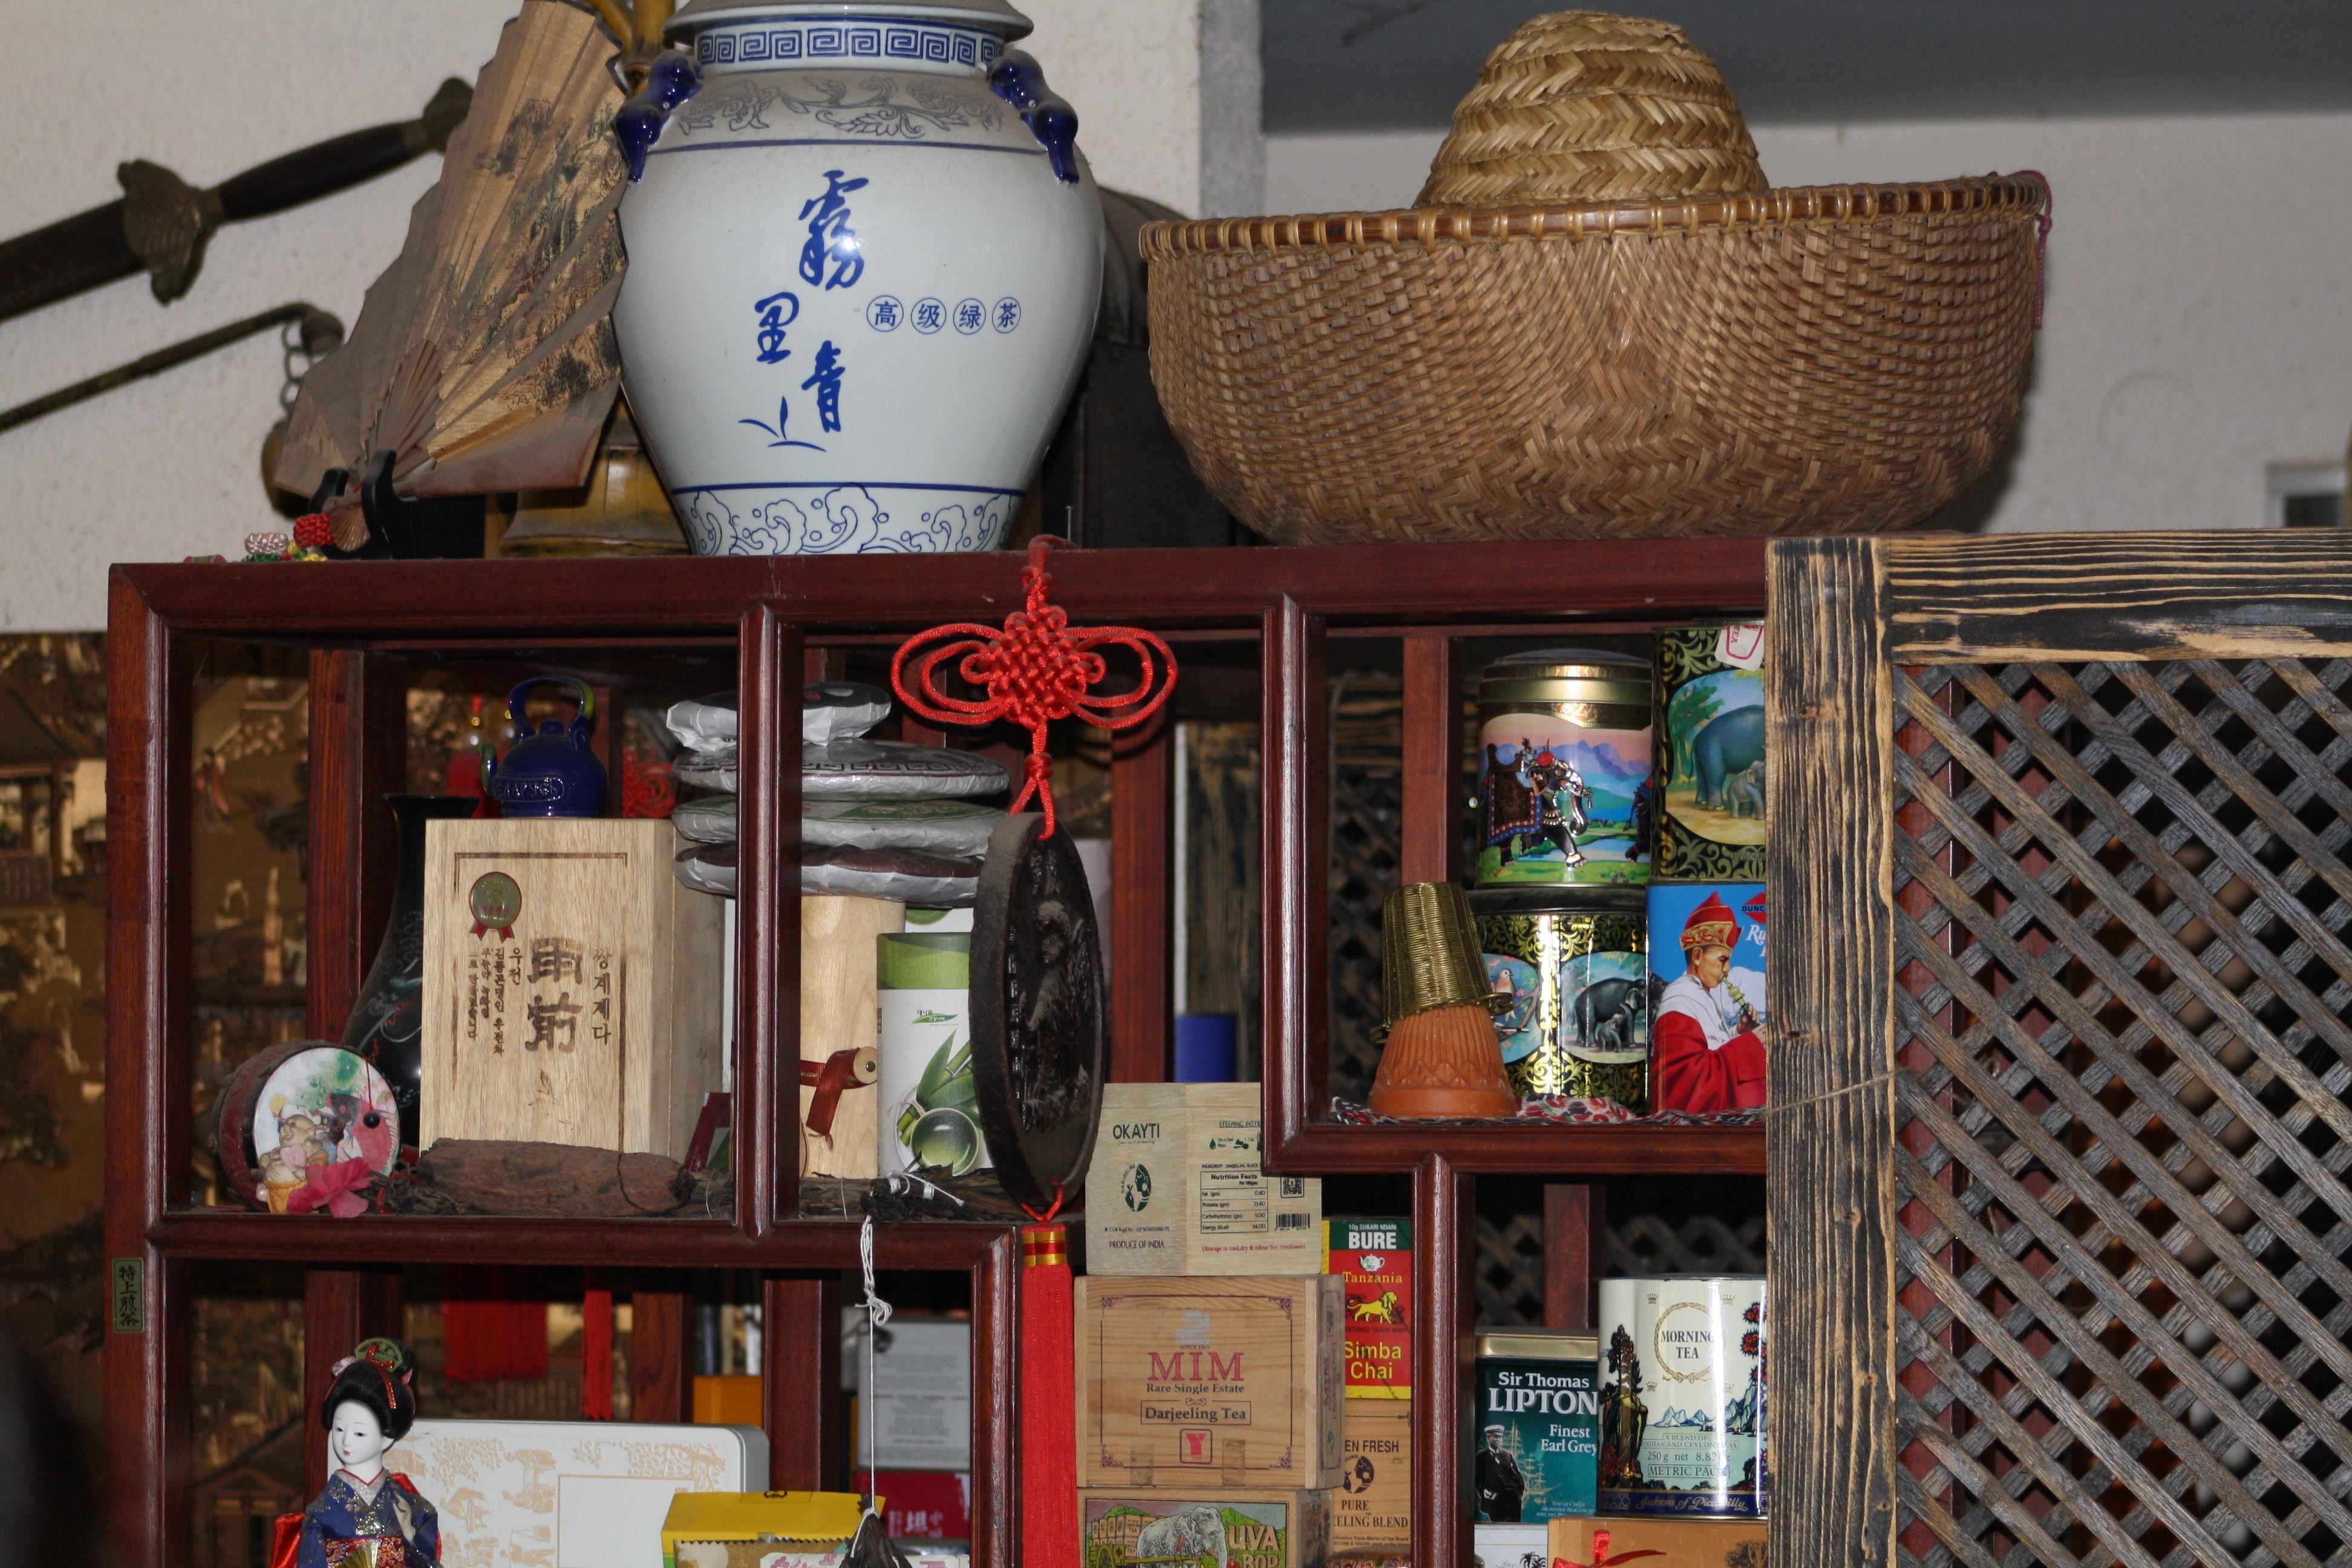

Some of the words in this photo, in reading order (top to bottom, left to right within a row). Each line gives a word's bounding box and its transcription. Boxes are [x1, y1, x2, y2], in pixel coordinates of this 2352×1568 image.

[870, 298, 1019, 332] 高级绿茶
[1113, 1123, 1160, 1139] OKAYTI
[1109, 1240, 1137, 1249] PRODUCE
[1348, 1232, 1397, 1250] BURE
[1342, 1272, 1402, 1283] Tanzania
[119, 1265, 139, 1327] 特上煎茶
[1345, 1341, 1402, 1359] Simba
[1676, 1347, 1699, 1359] TEA
[1148, 1351, 1244, 1381] MIM
[1351, 1361, 1392, 1379] Chai
[1498, 1371, 1522, 1386] Sir
[1525, 1373, 1590, 1388] Thomas
[1147, 1383, 1171, 1393] Rare
[1175, 1383, 1209, 1394] Single
[1213, 1383, 1244, 1393] Estate
[1488, 1388, 1597, 1415] LIPTON
[1146, 1407, 1218, 1422] Darjeeling
[1221, 1407, 1246, 1419] Tea
[1549, 1423, 1591, 1438] Finest
[1363, 1440, 1399, 1452] FRESH
[1541, 1439, 1566, 1452] Earl
[1568, 1440, 1597, 1457] Grey
[1648, 1452, 1662, 1460] 250
[1674, 1452, 1688, 1461] net
[1649, 1466, 1693, 1477] METRIC
[1342, 1500, 1369, 1511] PURE
[1675, 1497, 1692, 1511] of
[1373, 1517, 1408, 1527] BLEND
[1229, 1524, 1281, 1552] UVA
